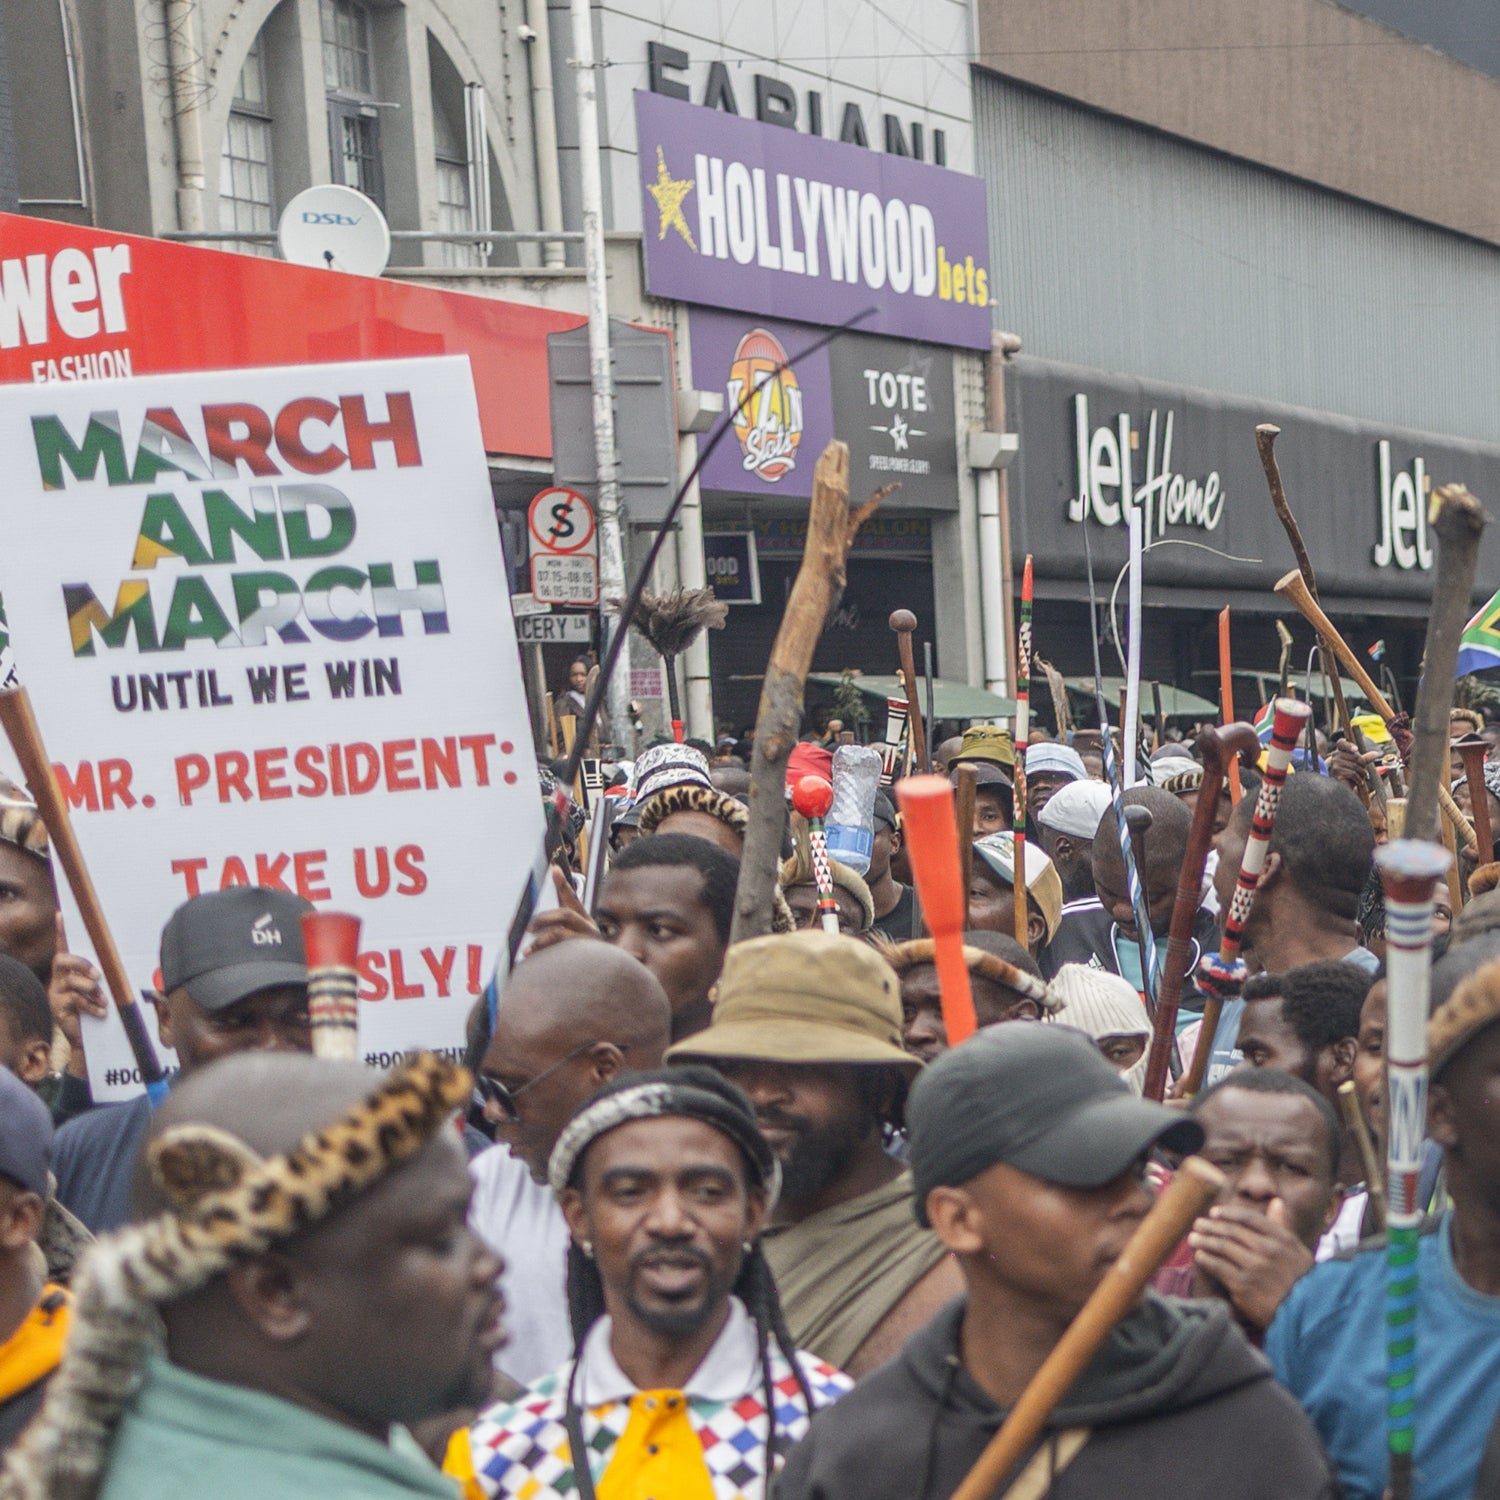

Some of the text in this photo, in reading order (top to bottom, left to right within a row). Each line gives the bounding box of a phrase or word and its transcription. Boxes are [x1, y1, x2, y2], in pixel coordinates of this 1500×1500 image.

[694, 153, 989, 307] HOLLYWOOD bets
[32, 348, 133, 384] FASHION
[864, 369, 927, 412] TOTE
[31, 390, 423, 491] MARCH
[1069, 393, 1226, 552] Jet Home
[131, 484, 356, 570] AND
[548, 504, 574, 537] S
[1374, 440, 1434, 569] Jet
[61, 558, 450, 657] MARCH
[111, 656, 403, 712] UNTIL WE WIN
[52, 733, 519, 813] MR. PRESIDENT:
[171, 843, 428, 901] TAKE US
